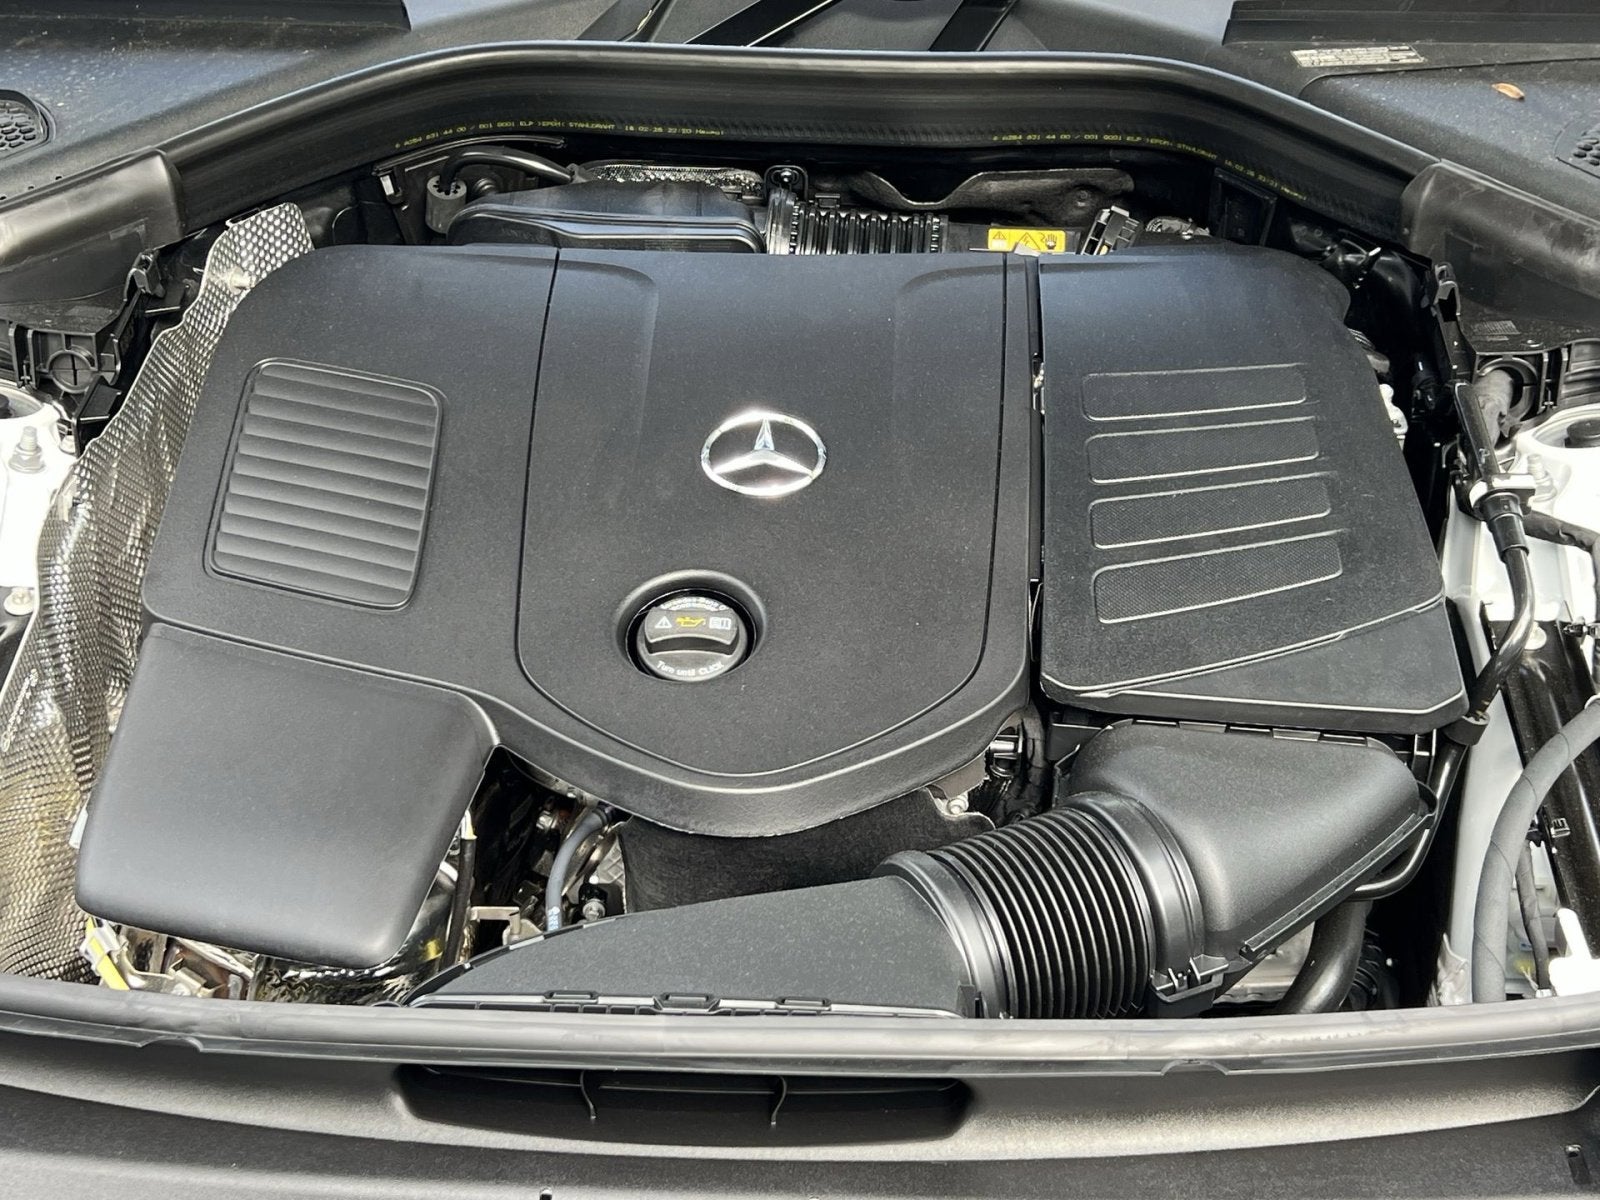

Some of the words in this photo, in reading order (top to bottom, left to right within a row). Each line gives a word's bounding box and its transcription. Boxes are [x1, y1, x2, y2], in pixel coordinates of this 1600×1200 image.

[656, 660, 675, 674] Turn
[676, 668, 696, 677] until
[698, 660, 725, 676] CLICK
